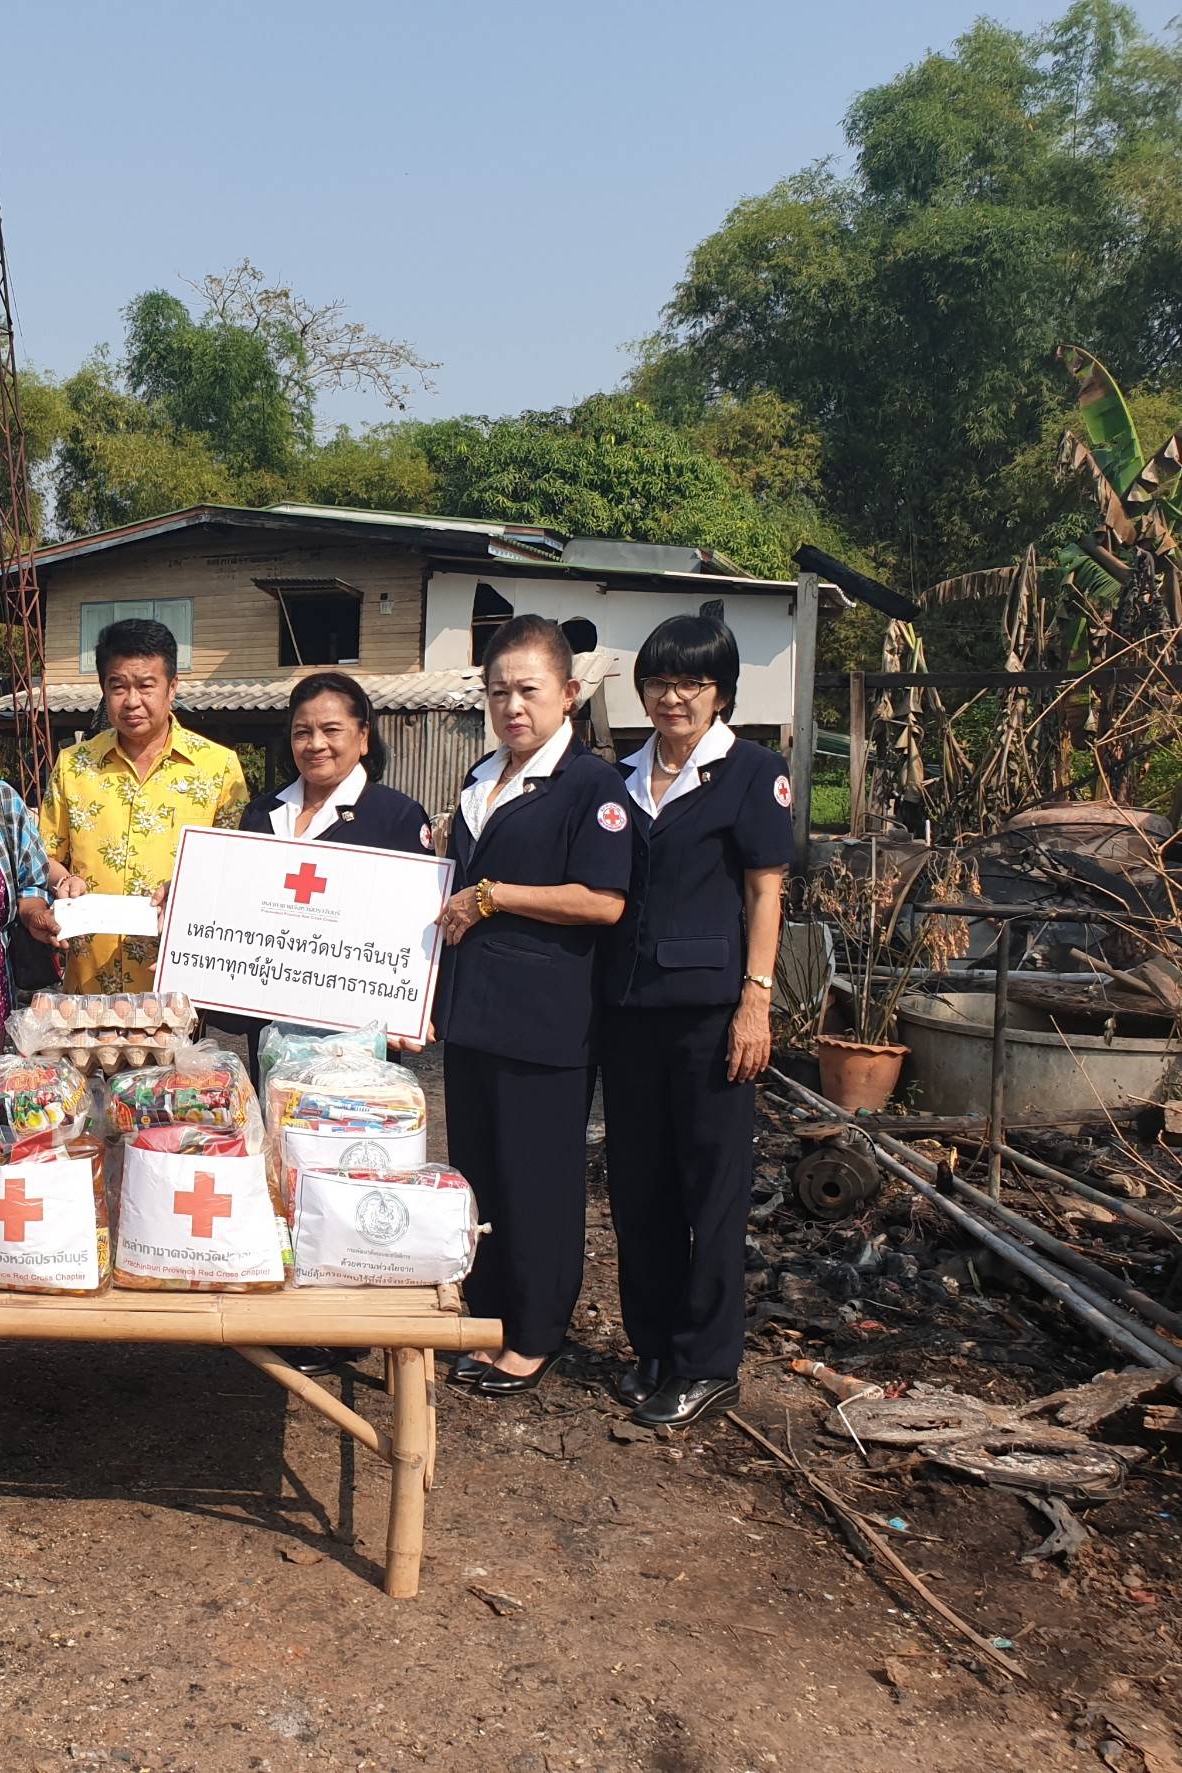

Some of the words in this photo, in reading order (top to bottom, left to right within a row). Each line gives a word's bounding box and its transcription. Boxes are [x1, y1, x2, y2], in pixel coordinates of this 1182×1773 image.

[186, 920, 411, 974] เหล่ากาชาดจังหวัดปราจีนบุรี
[170, 949, 418, 1002] บรรเทาทุกข์ผู้ประสบสาธารณภัย
[13, 1272, 28, 1280] Red
[55, 1272, 86, 1282] Chapter
[198, 1269, 214, 1277] Red
[216, 1270, 239, 1278] Cross
